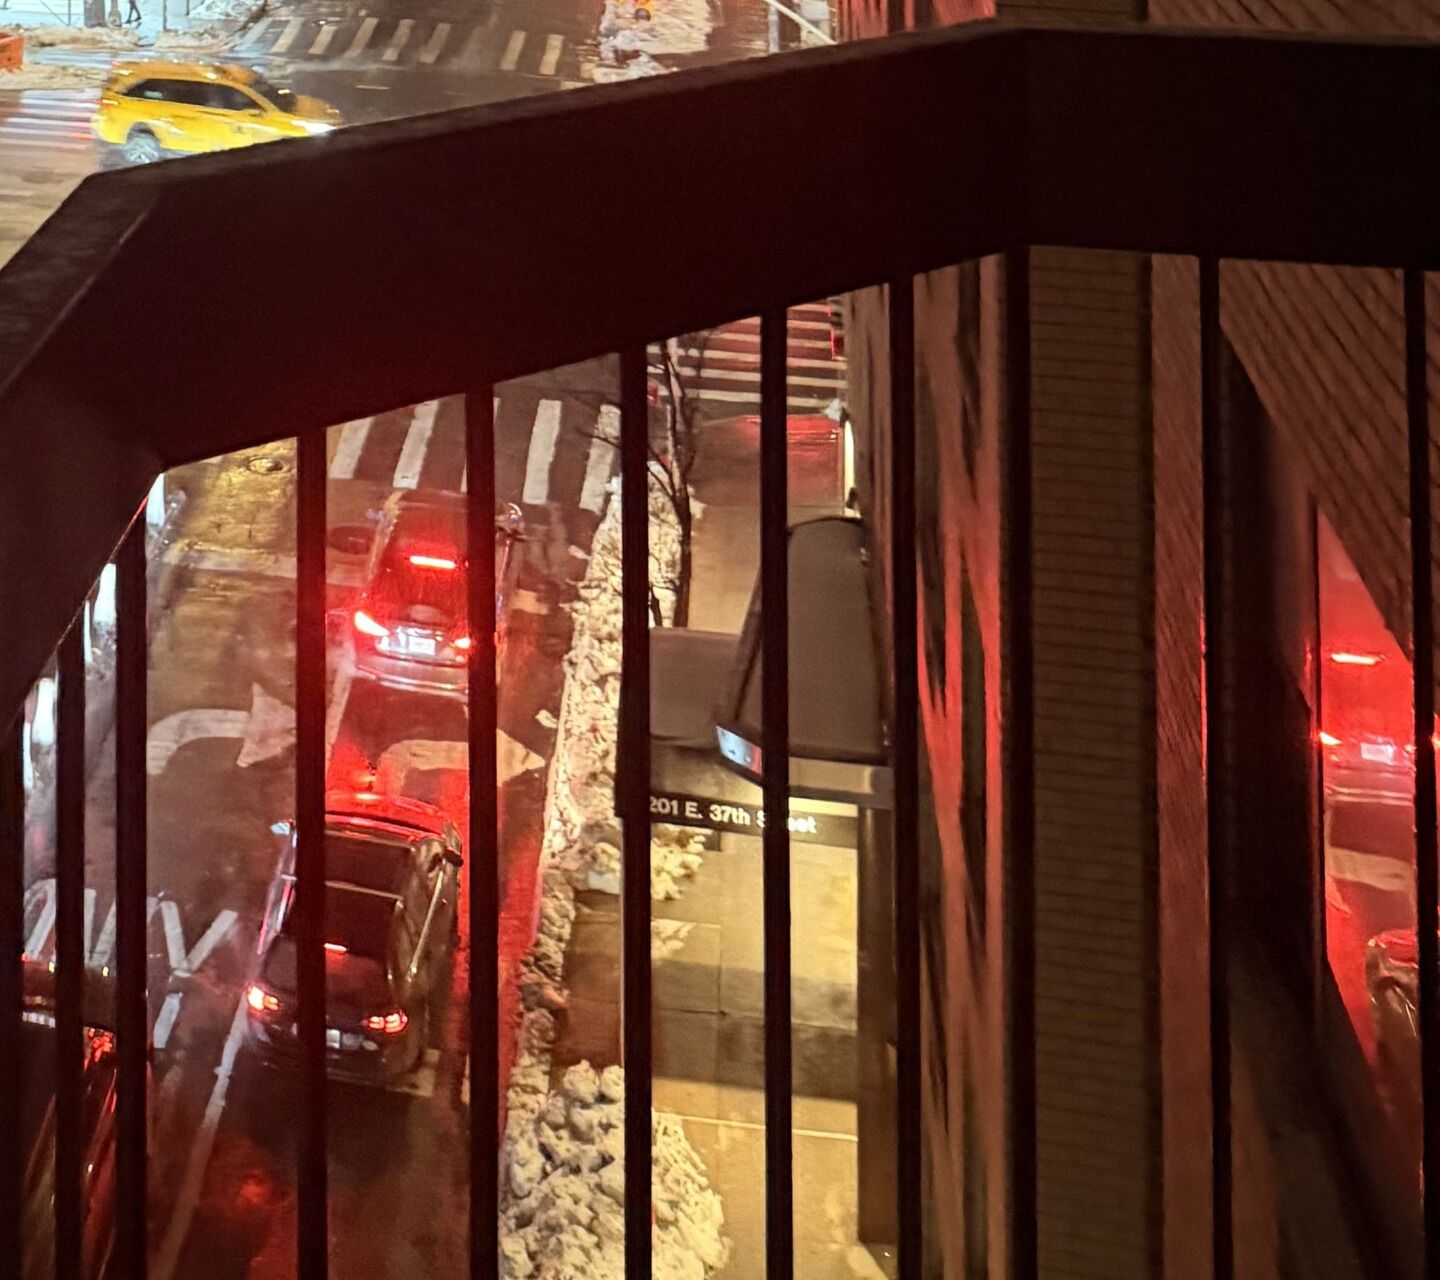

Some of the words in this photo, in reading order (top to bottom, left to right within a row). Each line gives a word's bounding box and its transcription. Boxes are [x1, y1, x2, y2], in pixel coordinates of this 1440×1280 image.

[649, 795, 679, 816] 201
[685, 800, 703, 819] E.
[709, 803, 751, 826] 37th
